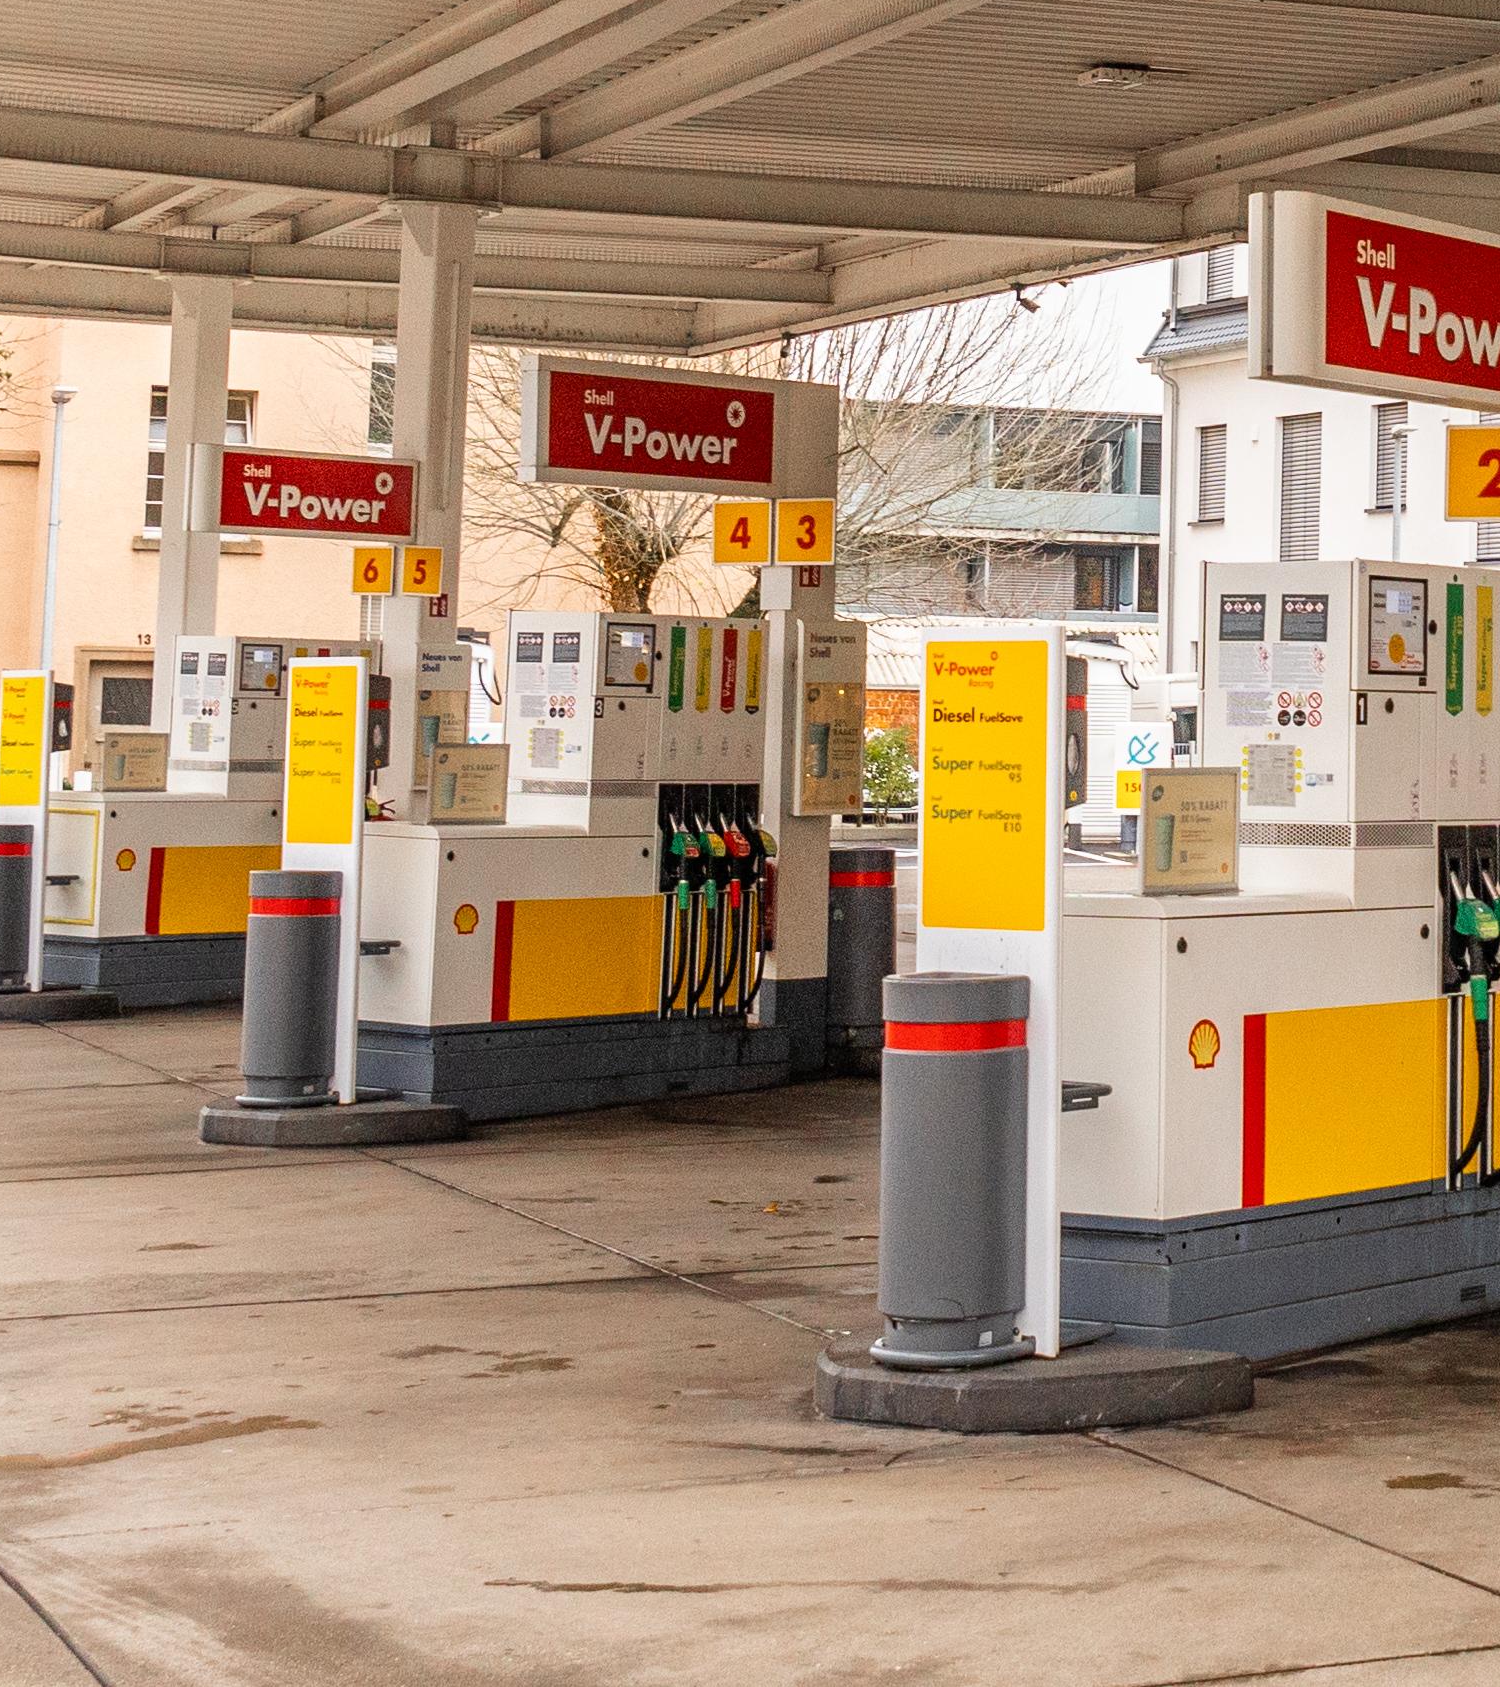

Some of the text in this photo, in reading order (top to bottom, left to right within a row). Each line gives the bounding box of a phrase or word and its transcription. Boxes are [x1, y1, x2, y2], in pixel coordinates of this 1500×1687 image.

[1356, 240, 1396, 270] Shell
[584, 389, 614, 406] Shell
[584, 412, 737, 465] V-Power
[243, 463, 272, 478] Shell
[243, 482, 386, 524] V-Power
[729, 516, 751, 549] 4
[796, 515, 816, 550] 3
[363, 558, 379, 584] 6
[413, 559, 427, 585] 5
[137, 634, 151, 645] 13
[810, 633, 856, 644] Neues von
[422, 653, 446, 662] Neues
[421, 664, 441, 673] Shell
[933, 662, 994, 676] V-Power
[295, 707, 318, 717] Diesel
[595, 700, 603, 716] 3
[933, 707, 1024, 723] Diesel FuelSave
[294, 737, 316, 749] Super
[932, 756, 1022, 774] Super FuelSave
[293, 768, 315, 779] Super
[1008, 773, 1022, 783] 95
[932, 805, 1022, 823] Super FuelSave
[1004, 822, 1022, 833] E10
